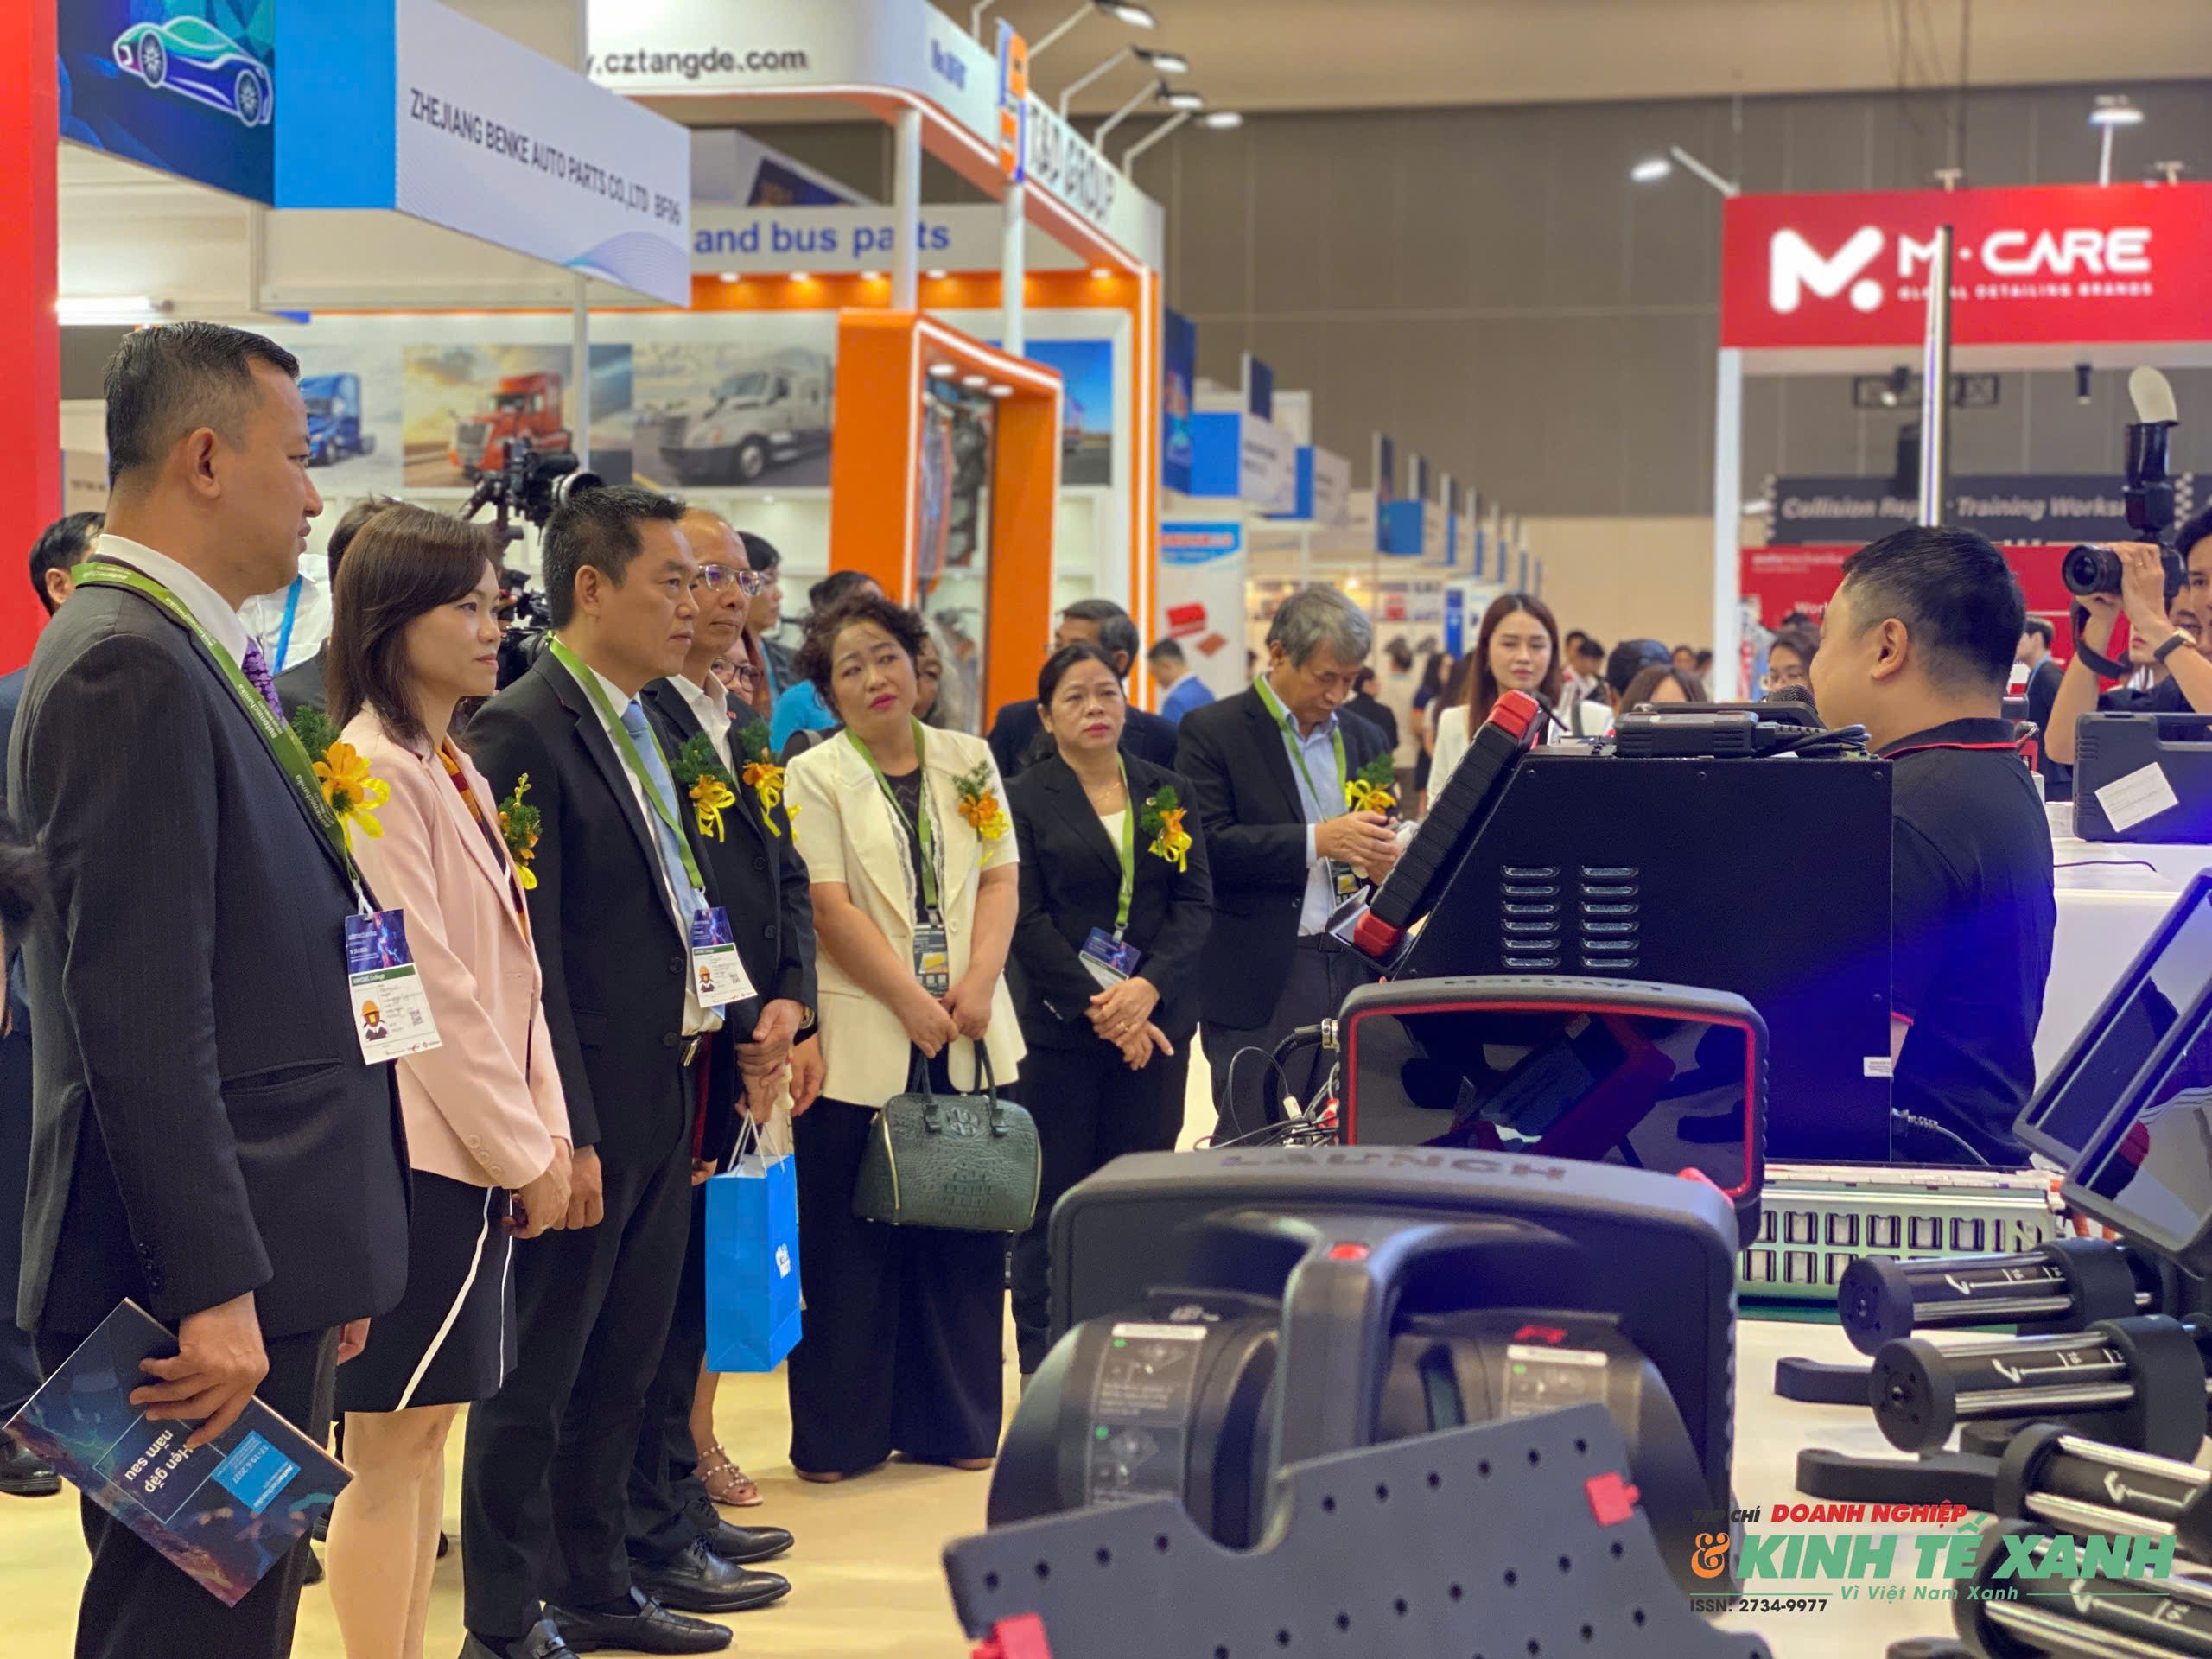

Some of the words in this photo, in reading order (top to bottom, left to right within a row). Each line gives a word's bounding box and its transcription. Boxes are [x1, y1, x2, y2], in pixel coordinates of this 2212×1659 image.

[588, 47, 807, 79] .cztangde.com
[410, 87, 482, 145] ZHEJIANG
[486, 119, 529, 164] BENKE
[531, 142, 566, 180] AUTO
[568, 156, 607, 195] PARTS
[694, 222, 760, 254] and
[772, 221, 837, 253] bus
[852, 221, 951, 258] pats
[1957, 494, 2047, 522] Training
[145, 1429, 174, 1459] năm
[165, 1444, 194, 1470] Hẹn
[124, 1457, 149, 1482] sau
[144, 1467, 168, 1494] gặp
